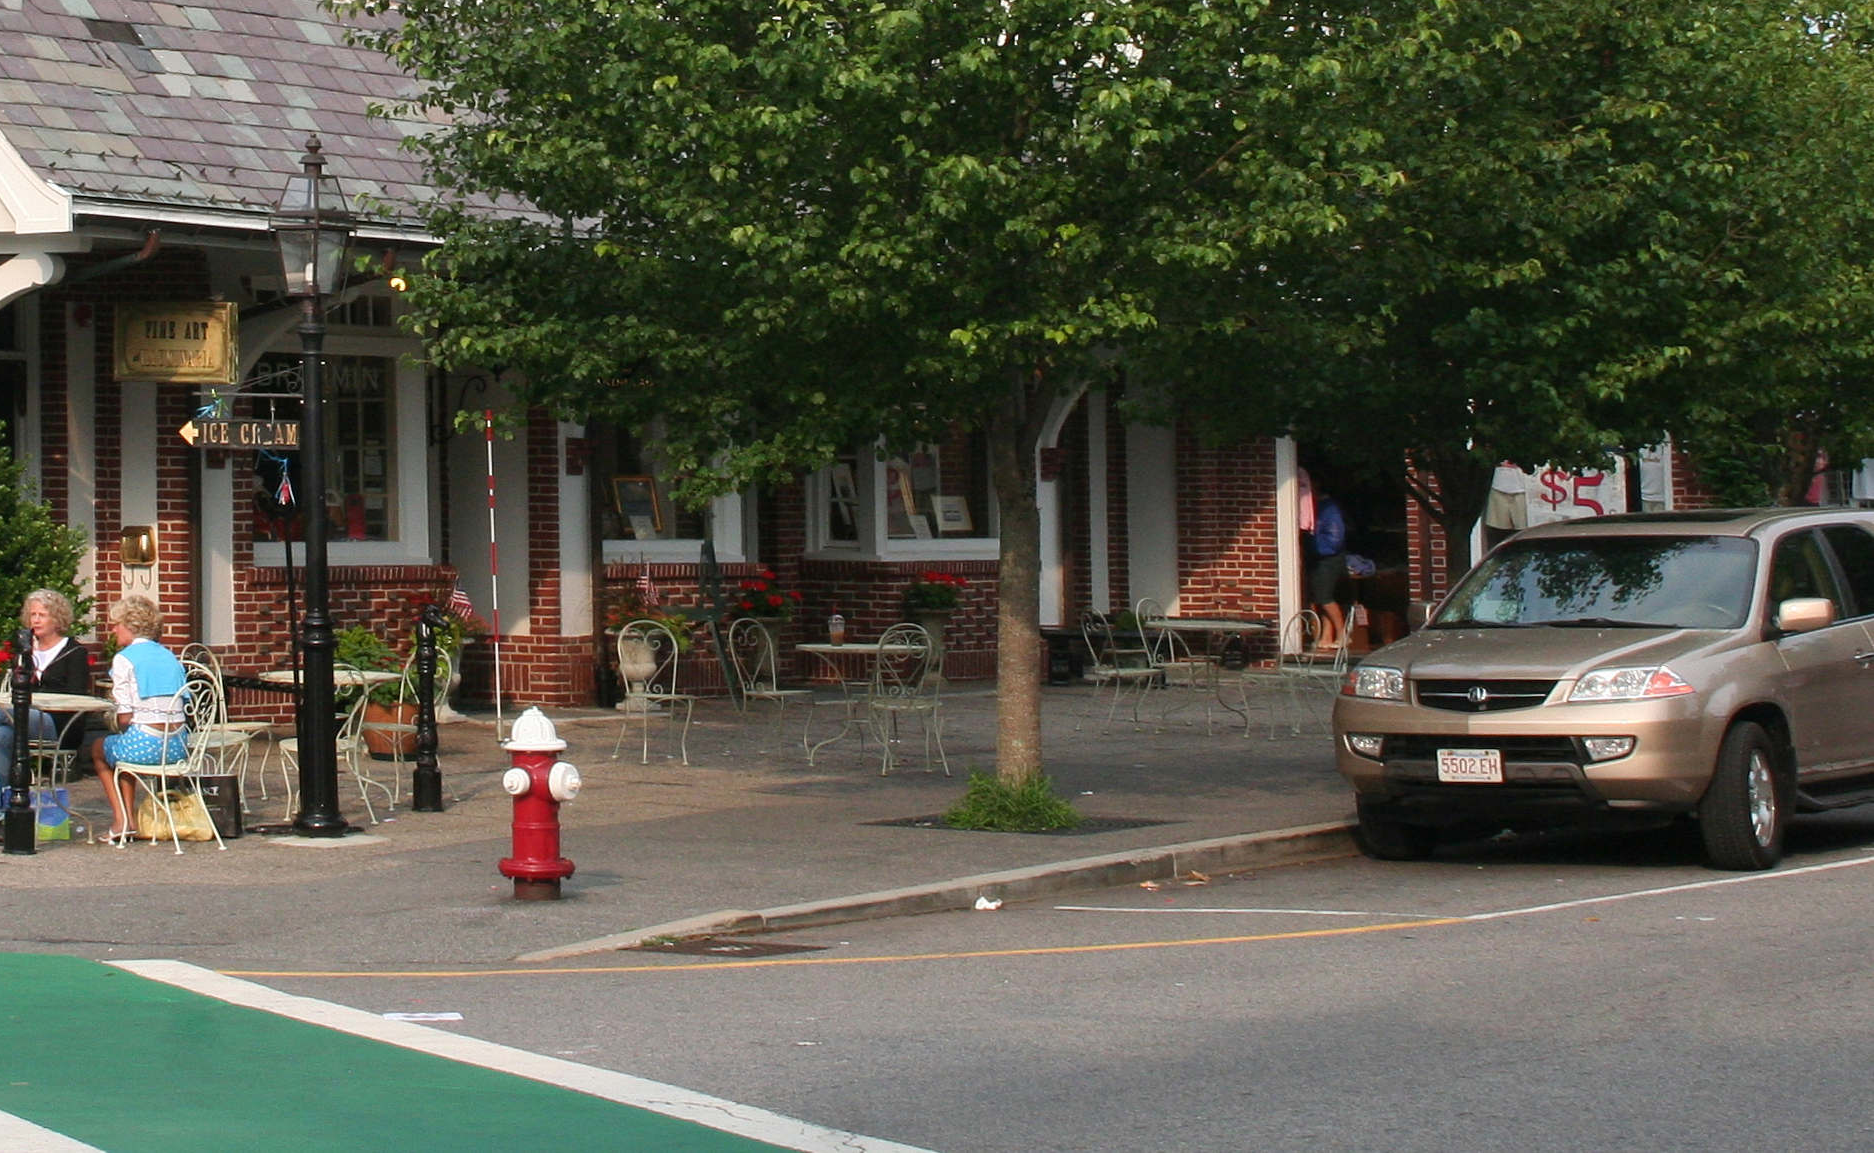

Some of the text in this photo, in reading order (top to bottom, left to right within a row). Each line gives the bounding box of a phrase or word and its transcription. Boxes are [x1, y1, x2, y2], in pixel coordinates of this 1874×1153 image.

[145, 320, 209, 340] FINE ART
[202, 422, 229, 445] ICE
[1539, 467, 1604, 516] $5
[1441, 757, 1499, 775] 5502 EH
